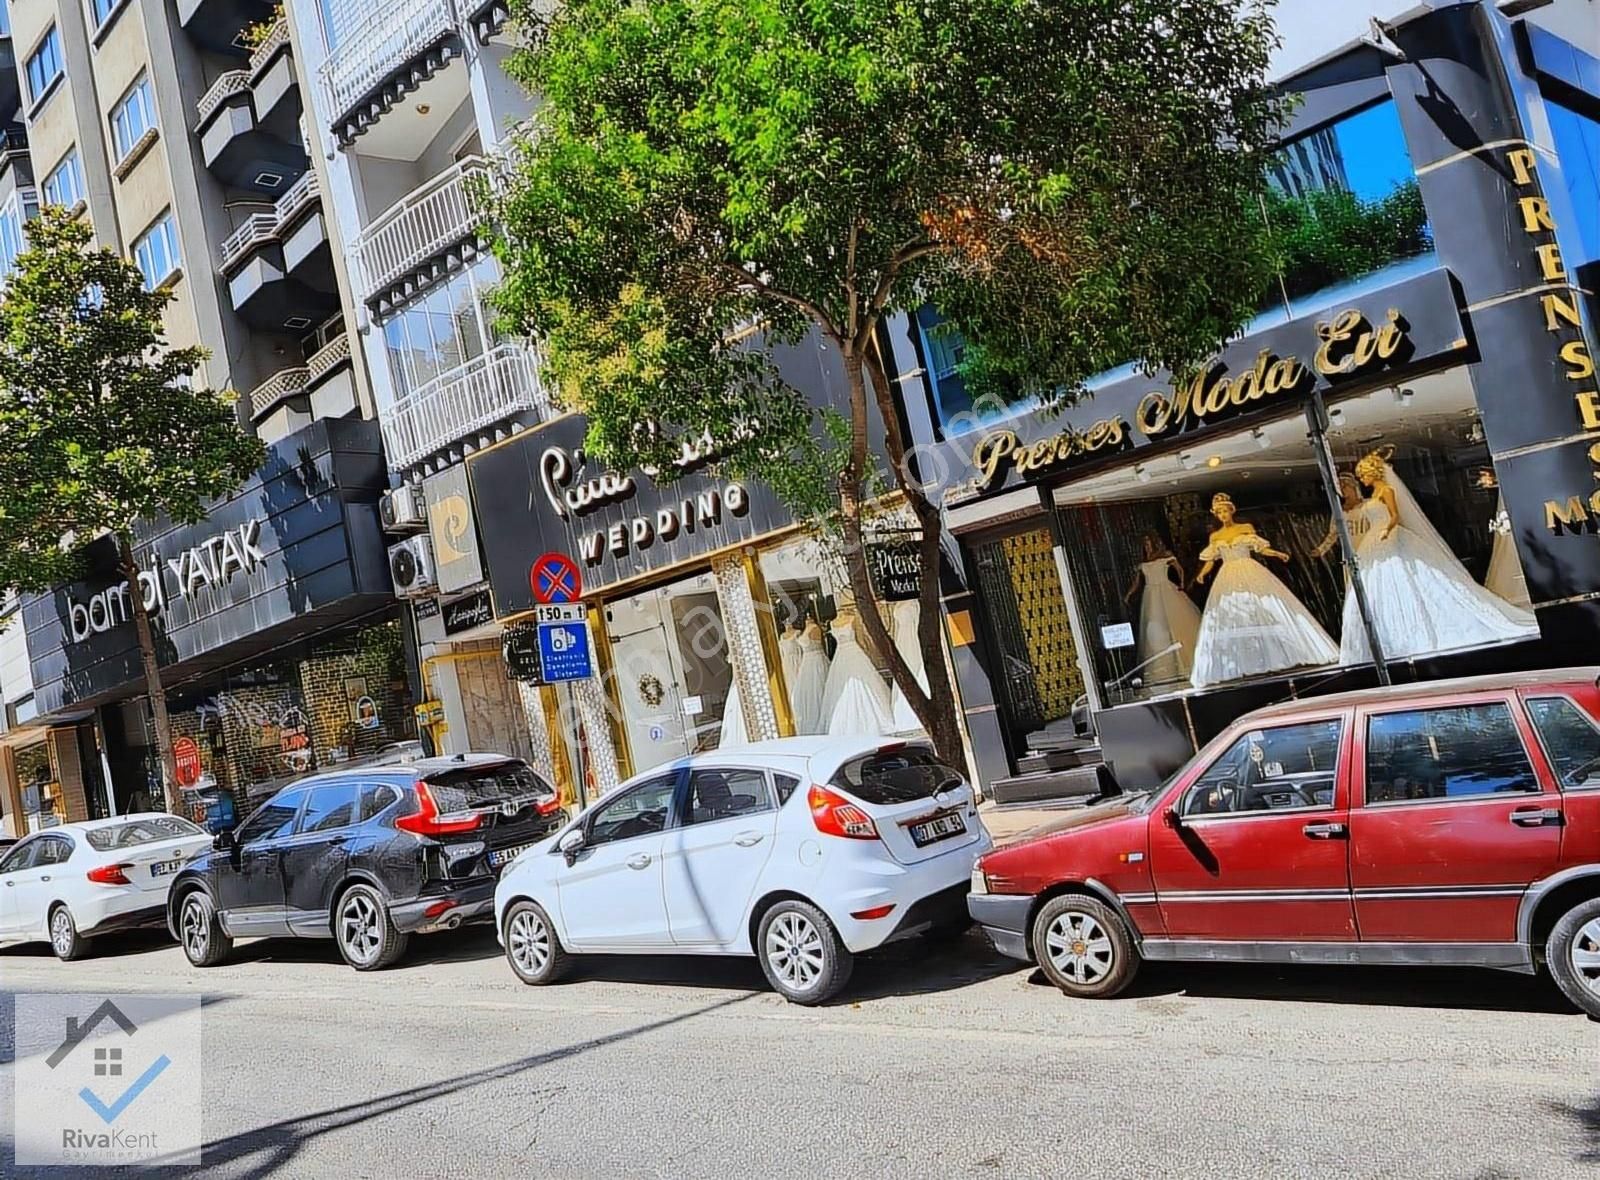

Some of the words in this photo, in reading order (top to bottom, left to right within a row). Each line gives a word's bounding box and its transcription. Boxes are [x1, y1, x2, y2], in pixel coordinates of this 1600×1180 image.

[972, 428, 1123, 491] Prenses
[1135, 347, 1305, 436] Moda
[1313, 307, 1402, 376] Evi
[167, 518, 268, 600] YATAK
[577, 481, 750, 568] WEDDING
[546, 606, 560, 620] 50
